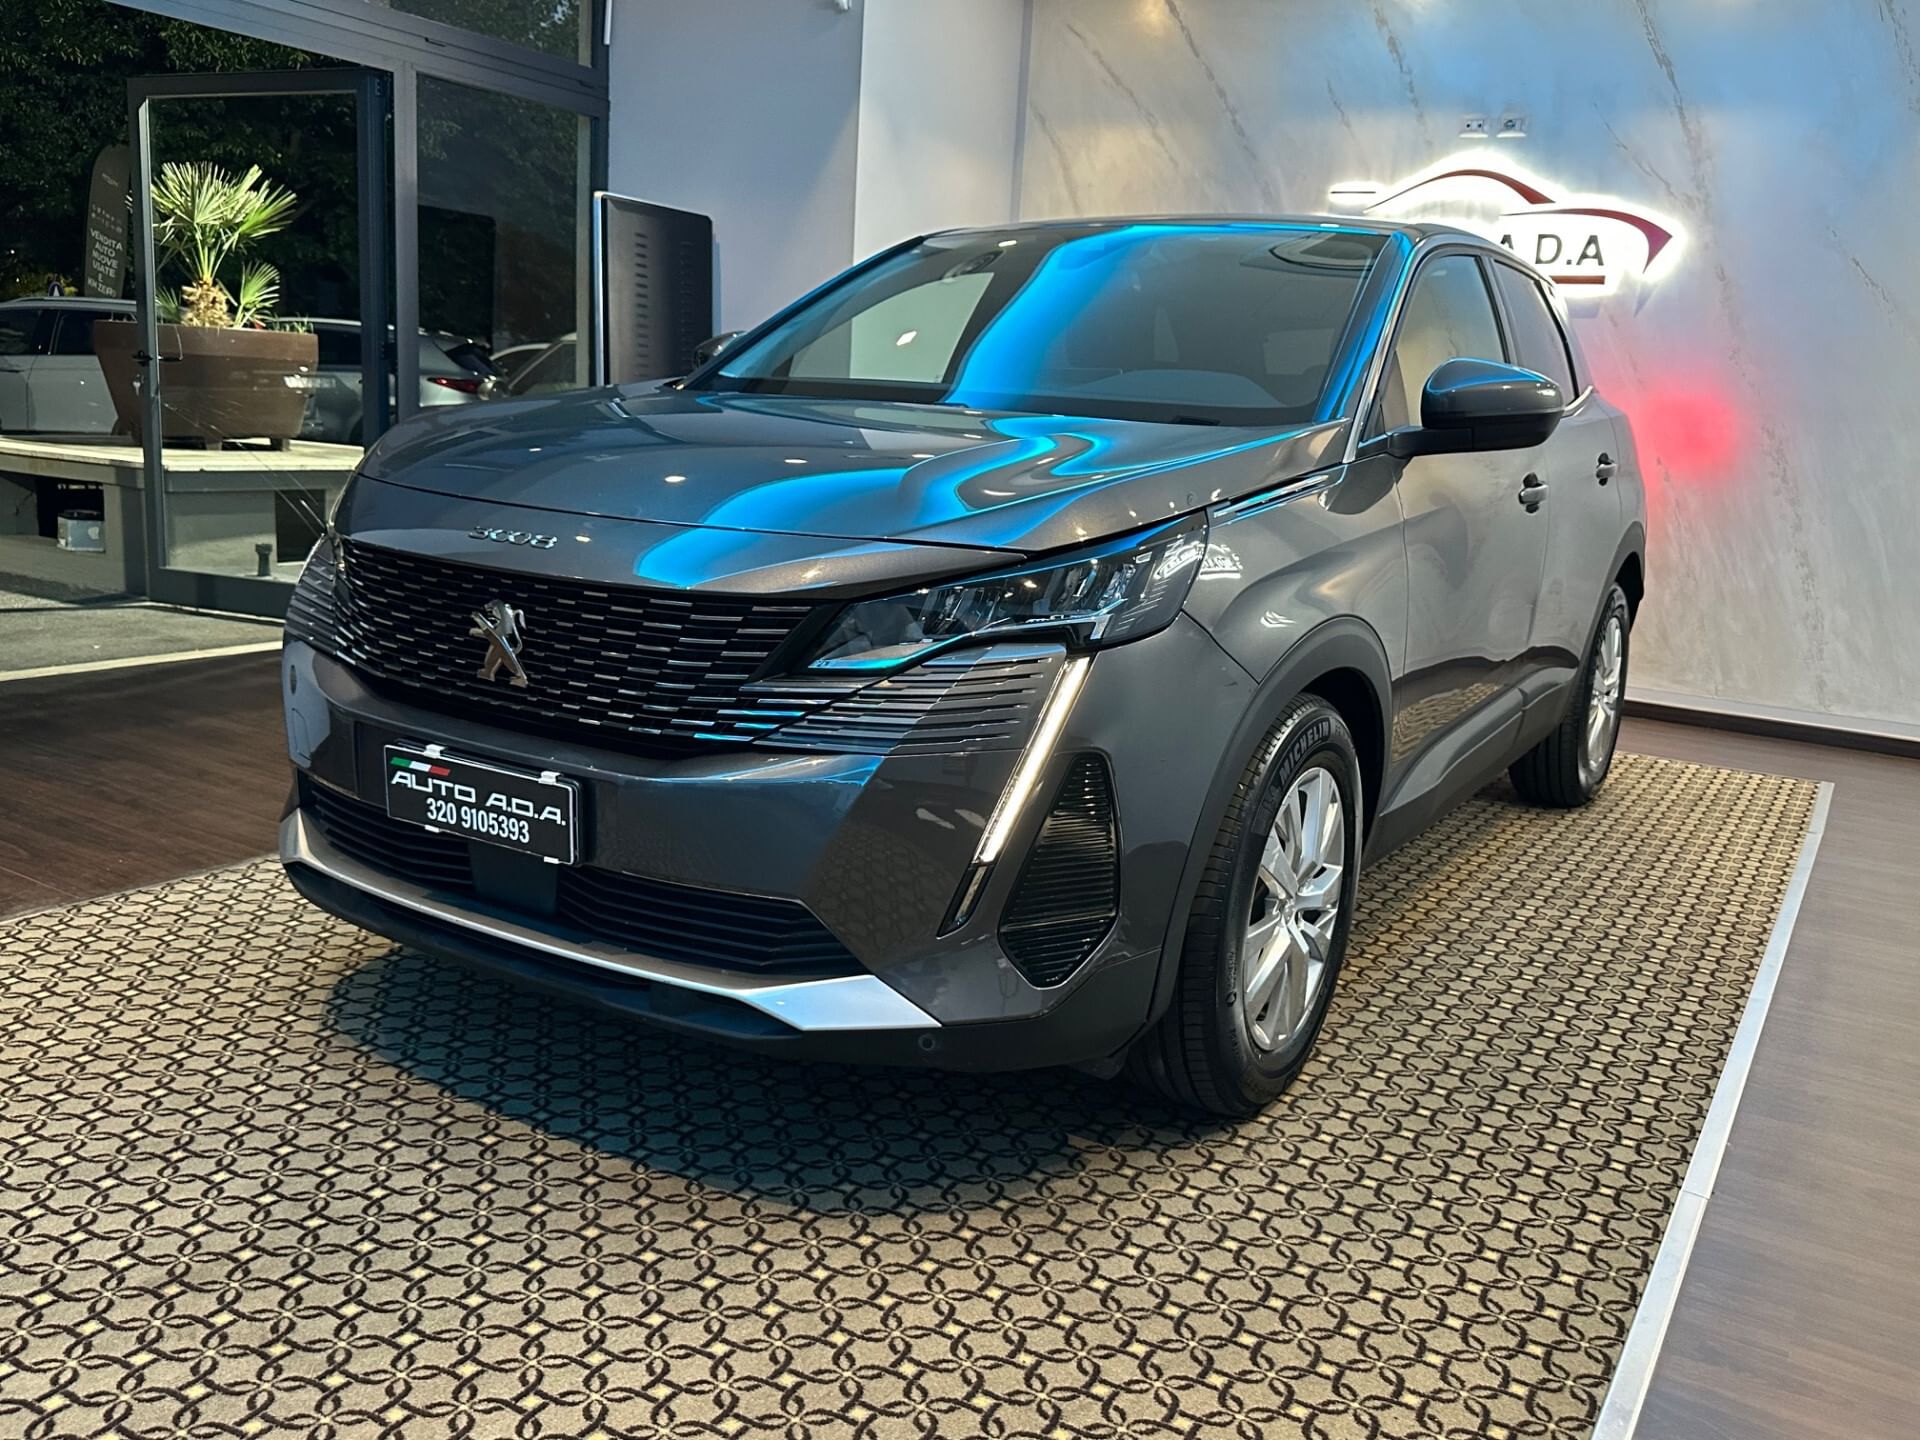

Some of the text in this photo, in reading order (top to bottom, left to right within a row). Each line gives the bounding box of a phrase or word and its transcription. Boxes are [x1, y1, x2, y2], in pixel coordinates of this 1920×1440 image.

[90, 228, 123, 251] VENDITA
[95, 241, 116, 258] AUTO
[92, 249, 119, 269] NUOVE
[468, 526, 558, 550] 3008
[1279, 721, 1329, 785] MICHELIN
[390, 770, 567, 826] AUTO A.D.A.
[426, 797, 530, 844] 320 9105393
